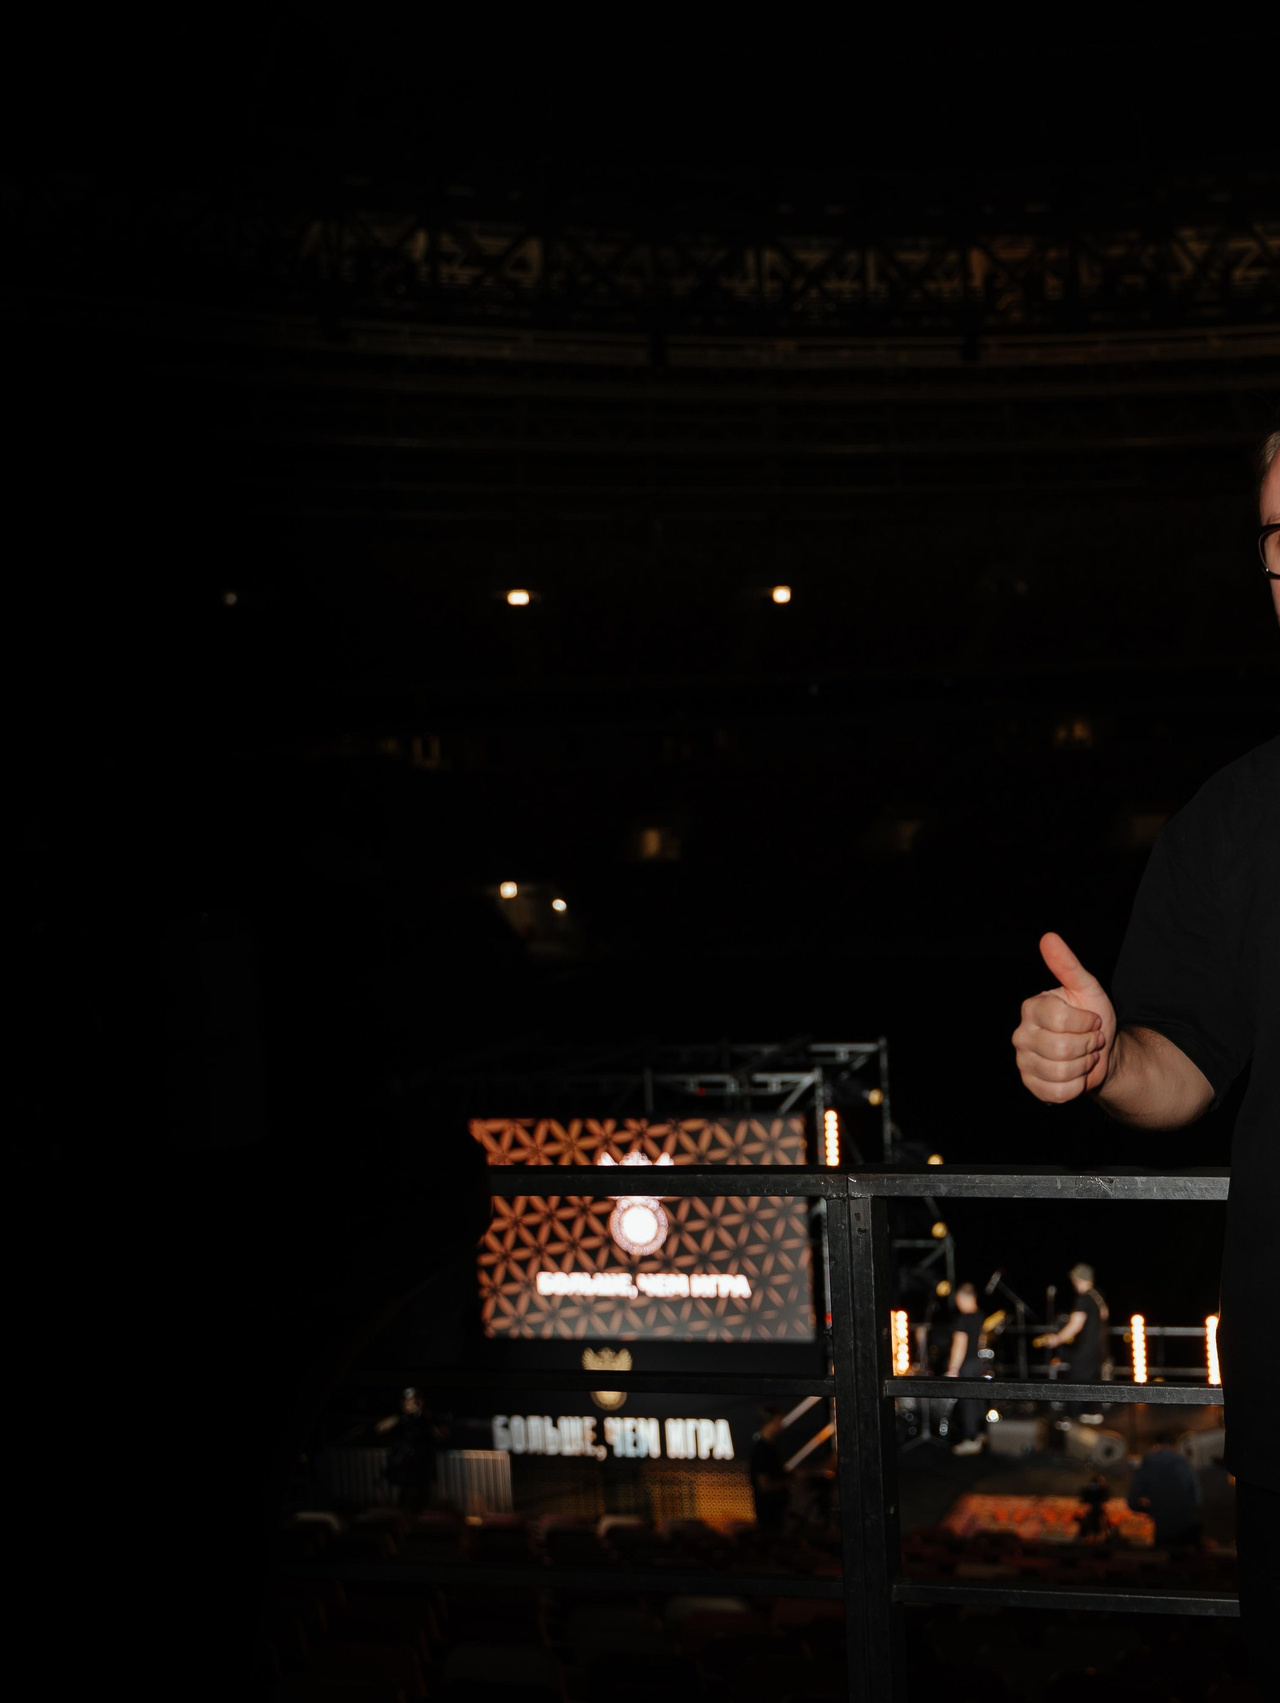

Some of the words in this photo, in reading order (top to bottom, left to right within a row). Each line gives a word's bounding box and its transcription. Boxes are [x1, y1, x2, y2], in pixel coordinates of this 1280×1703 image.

[492, 1415, 607, 1461] БОЛЬШЕ,
[603, 1416, 661, 1459] ЧЕМ
[665, 1418, 735, 1460] ИГРА
